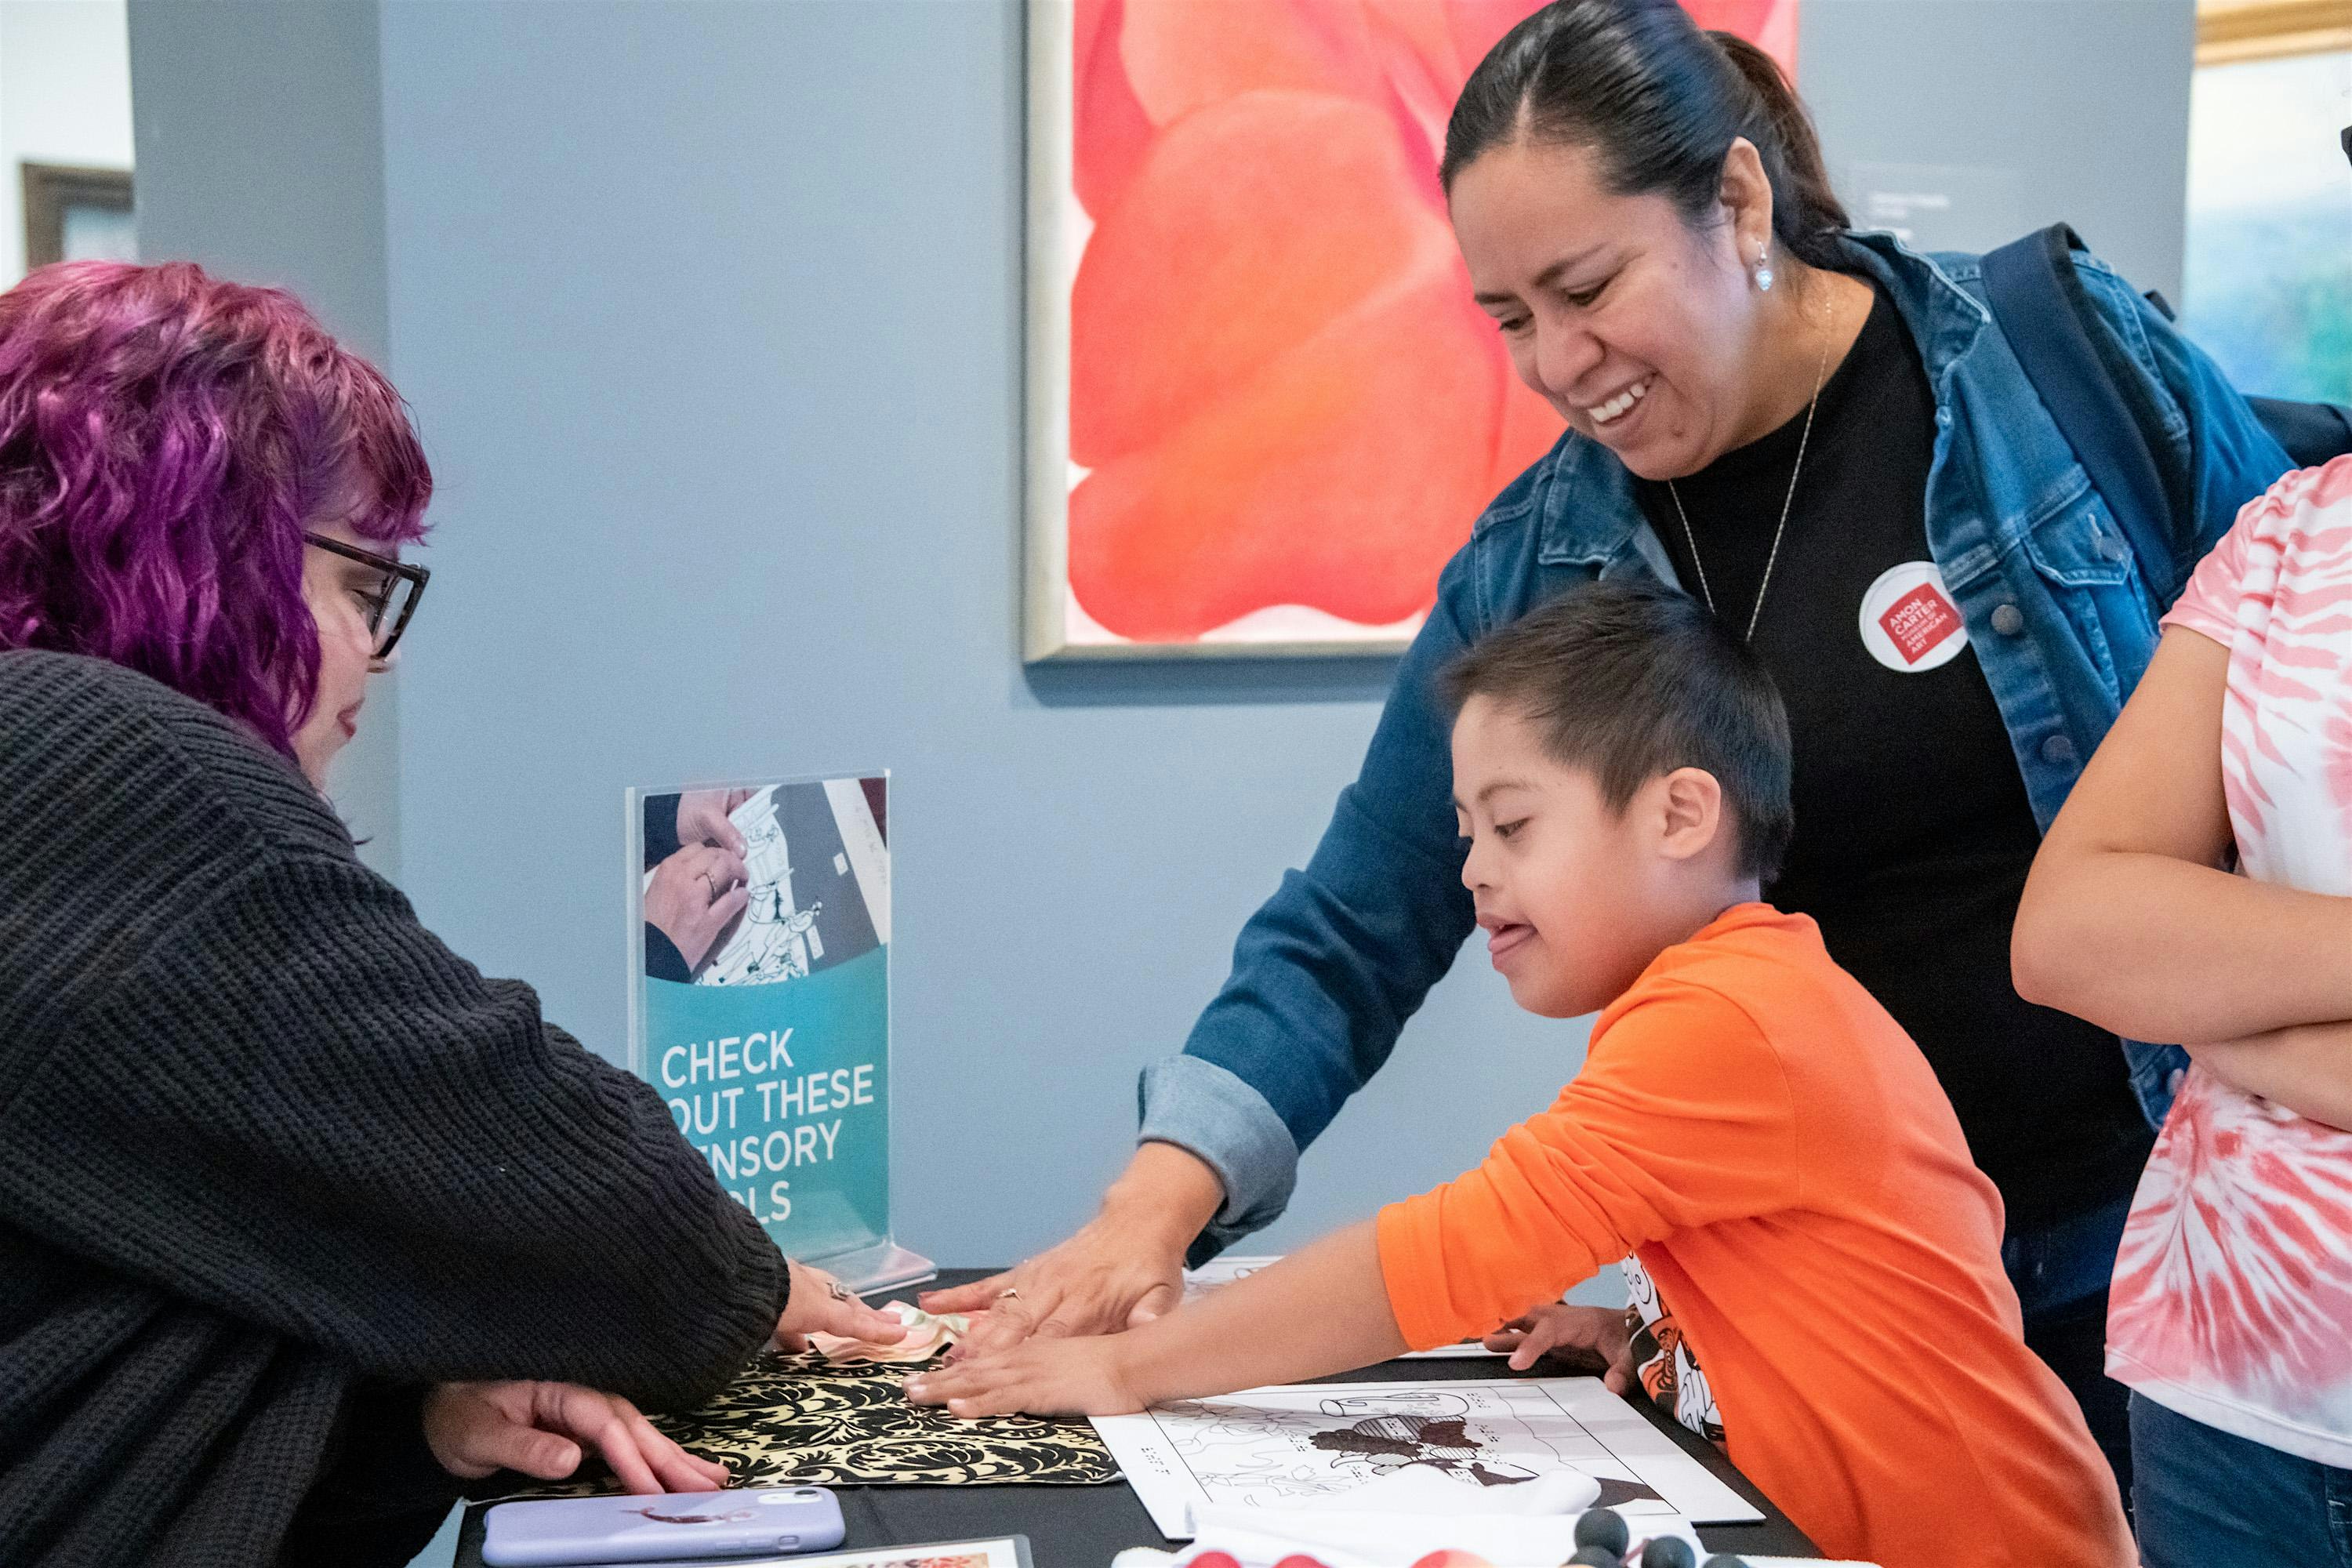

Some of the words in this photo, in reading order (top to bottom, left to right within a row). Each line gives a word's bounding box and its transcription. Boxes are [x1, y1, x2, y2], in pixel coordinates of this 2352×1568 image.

[1889, 598, 1922, 627] AMON
[1895, 600, 1937, 635] CARTER
[1911, 638, 1927, 654] ART
[662, 1028, 793, 1088] CHECK
[756, 1064, 874, 1122] THESE
[696, 1119, 842, 1180] NSORY
